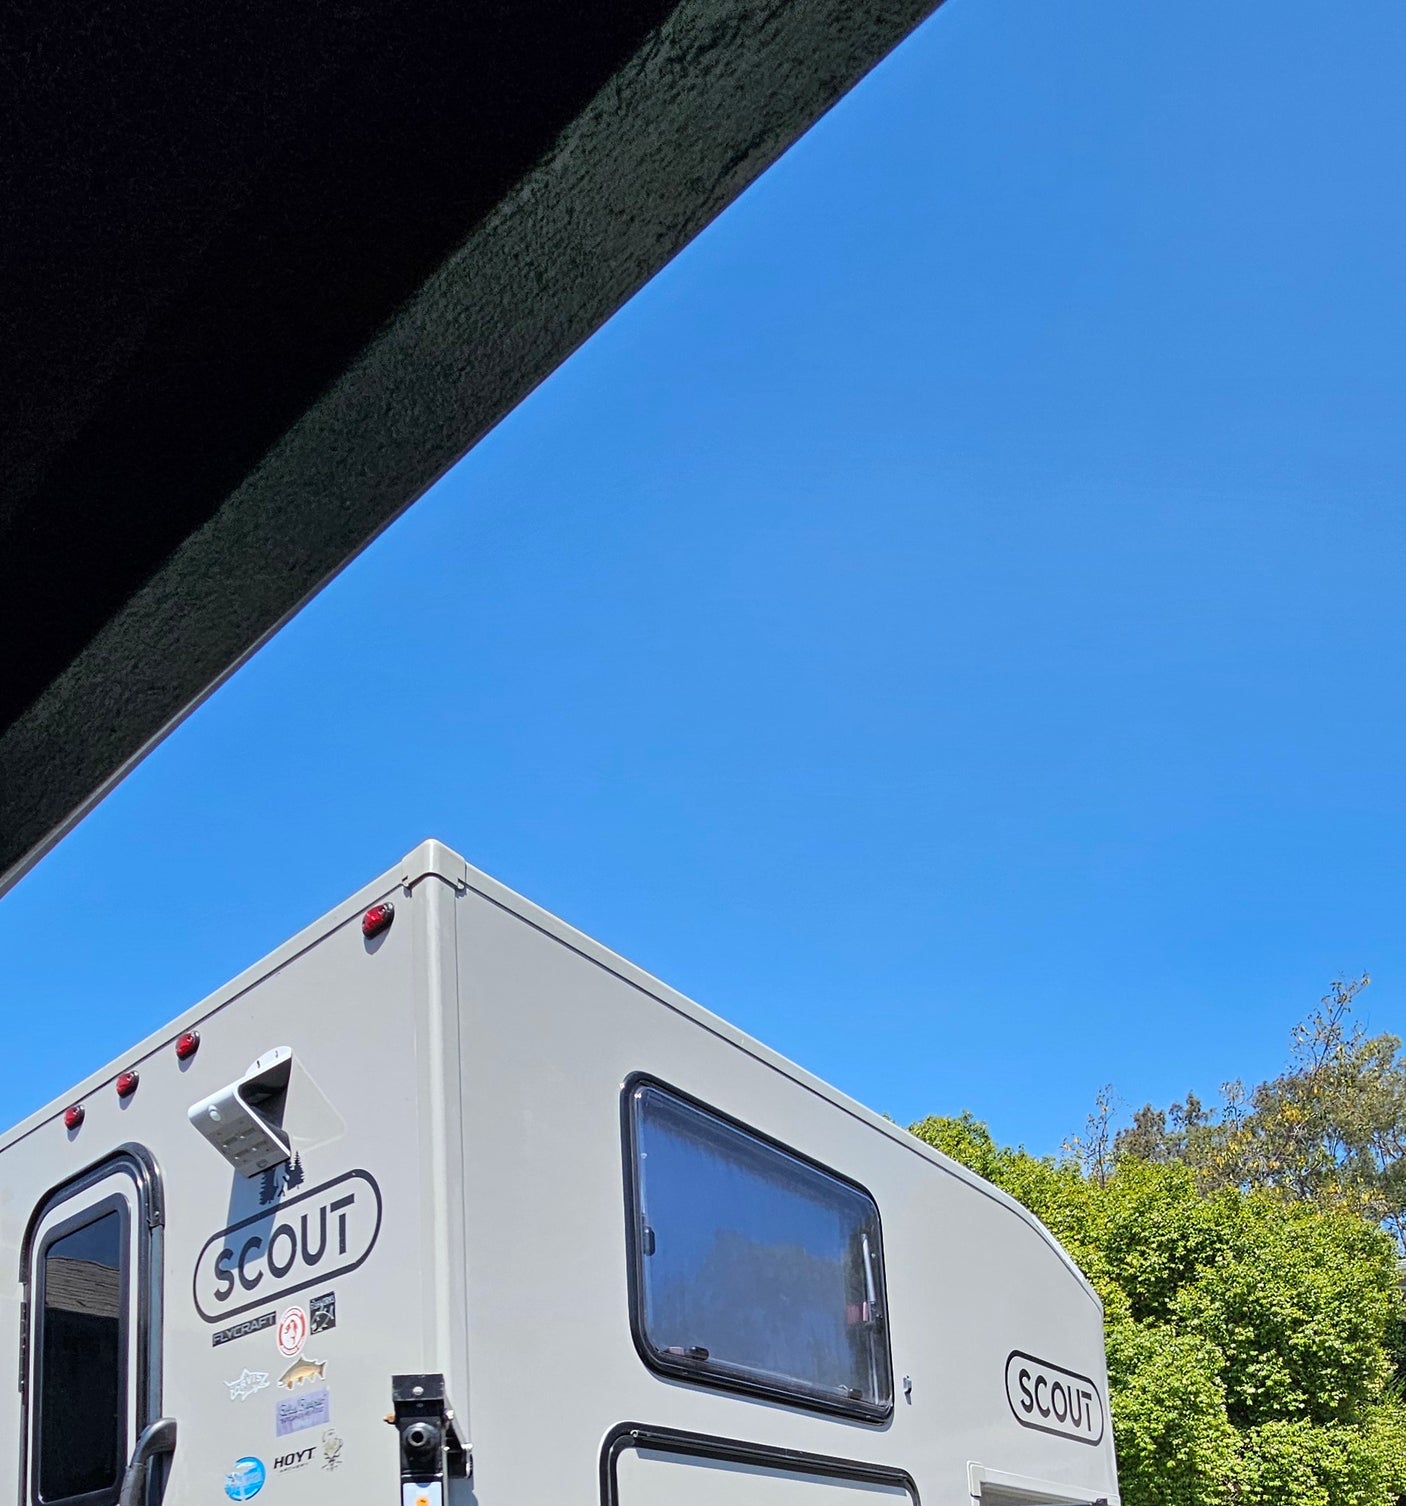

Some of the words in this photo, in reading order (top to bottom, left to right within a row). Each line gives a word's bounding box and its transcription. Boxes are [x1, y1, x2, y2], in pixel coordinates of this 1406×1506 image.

[214, 1193, 355, 1302] SCOUT
[213, 1313, 276, 1345] FLYCRAFT
[1019, 1368, 1092, 1432] SCOUT
[273, 1446, 317, 1469] HOYT
